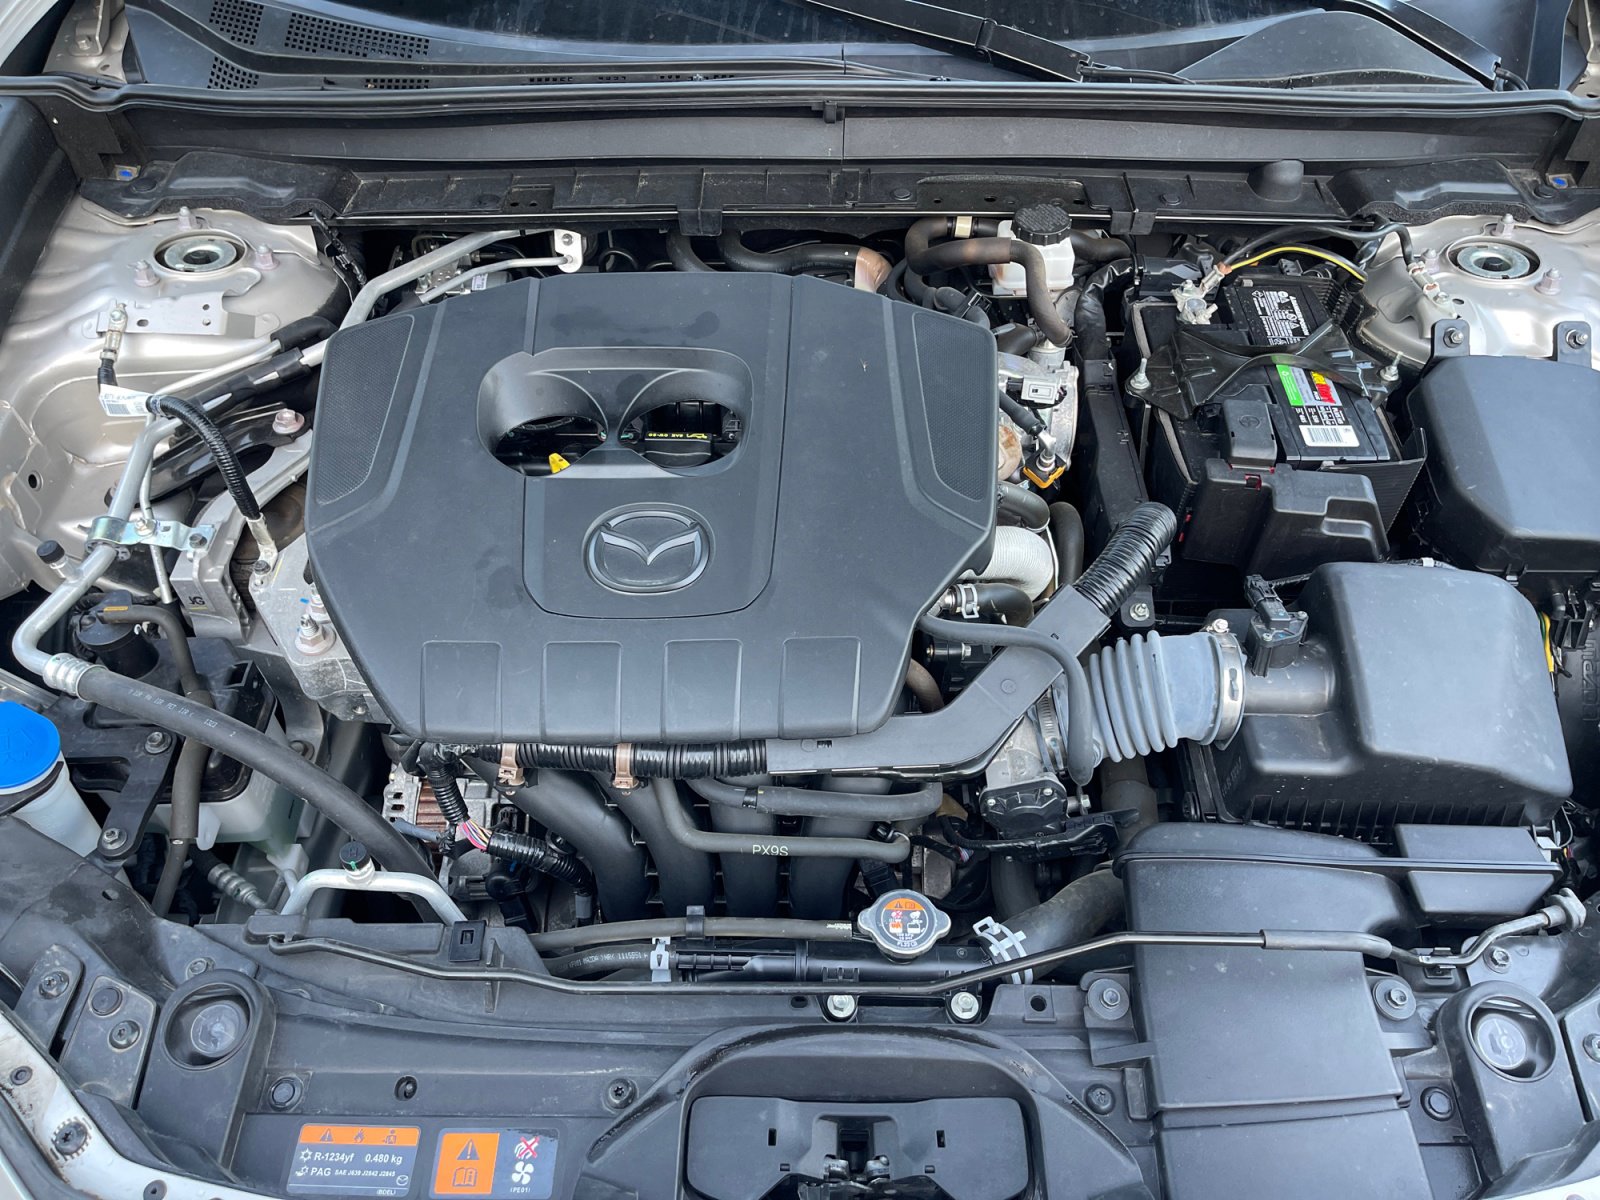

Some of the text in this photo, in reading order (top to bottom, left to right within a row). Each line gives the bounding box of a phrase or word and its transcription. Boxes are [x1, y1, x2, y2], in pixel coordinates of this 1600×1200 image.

[752, 844, 789, 856] PX9S
[313, 1151, 403, 1165] R-1234yf 0.480 kg
[310, 1167, 331, 1176] PAG
